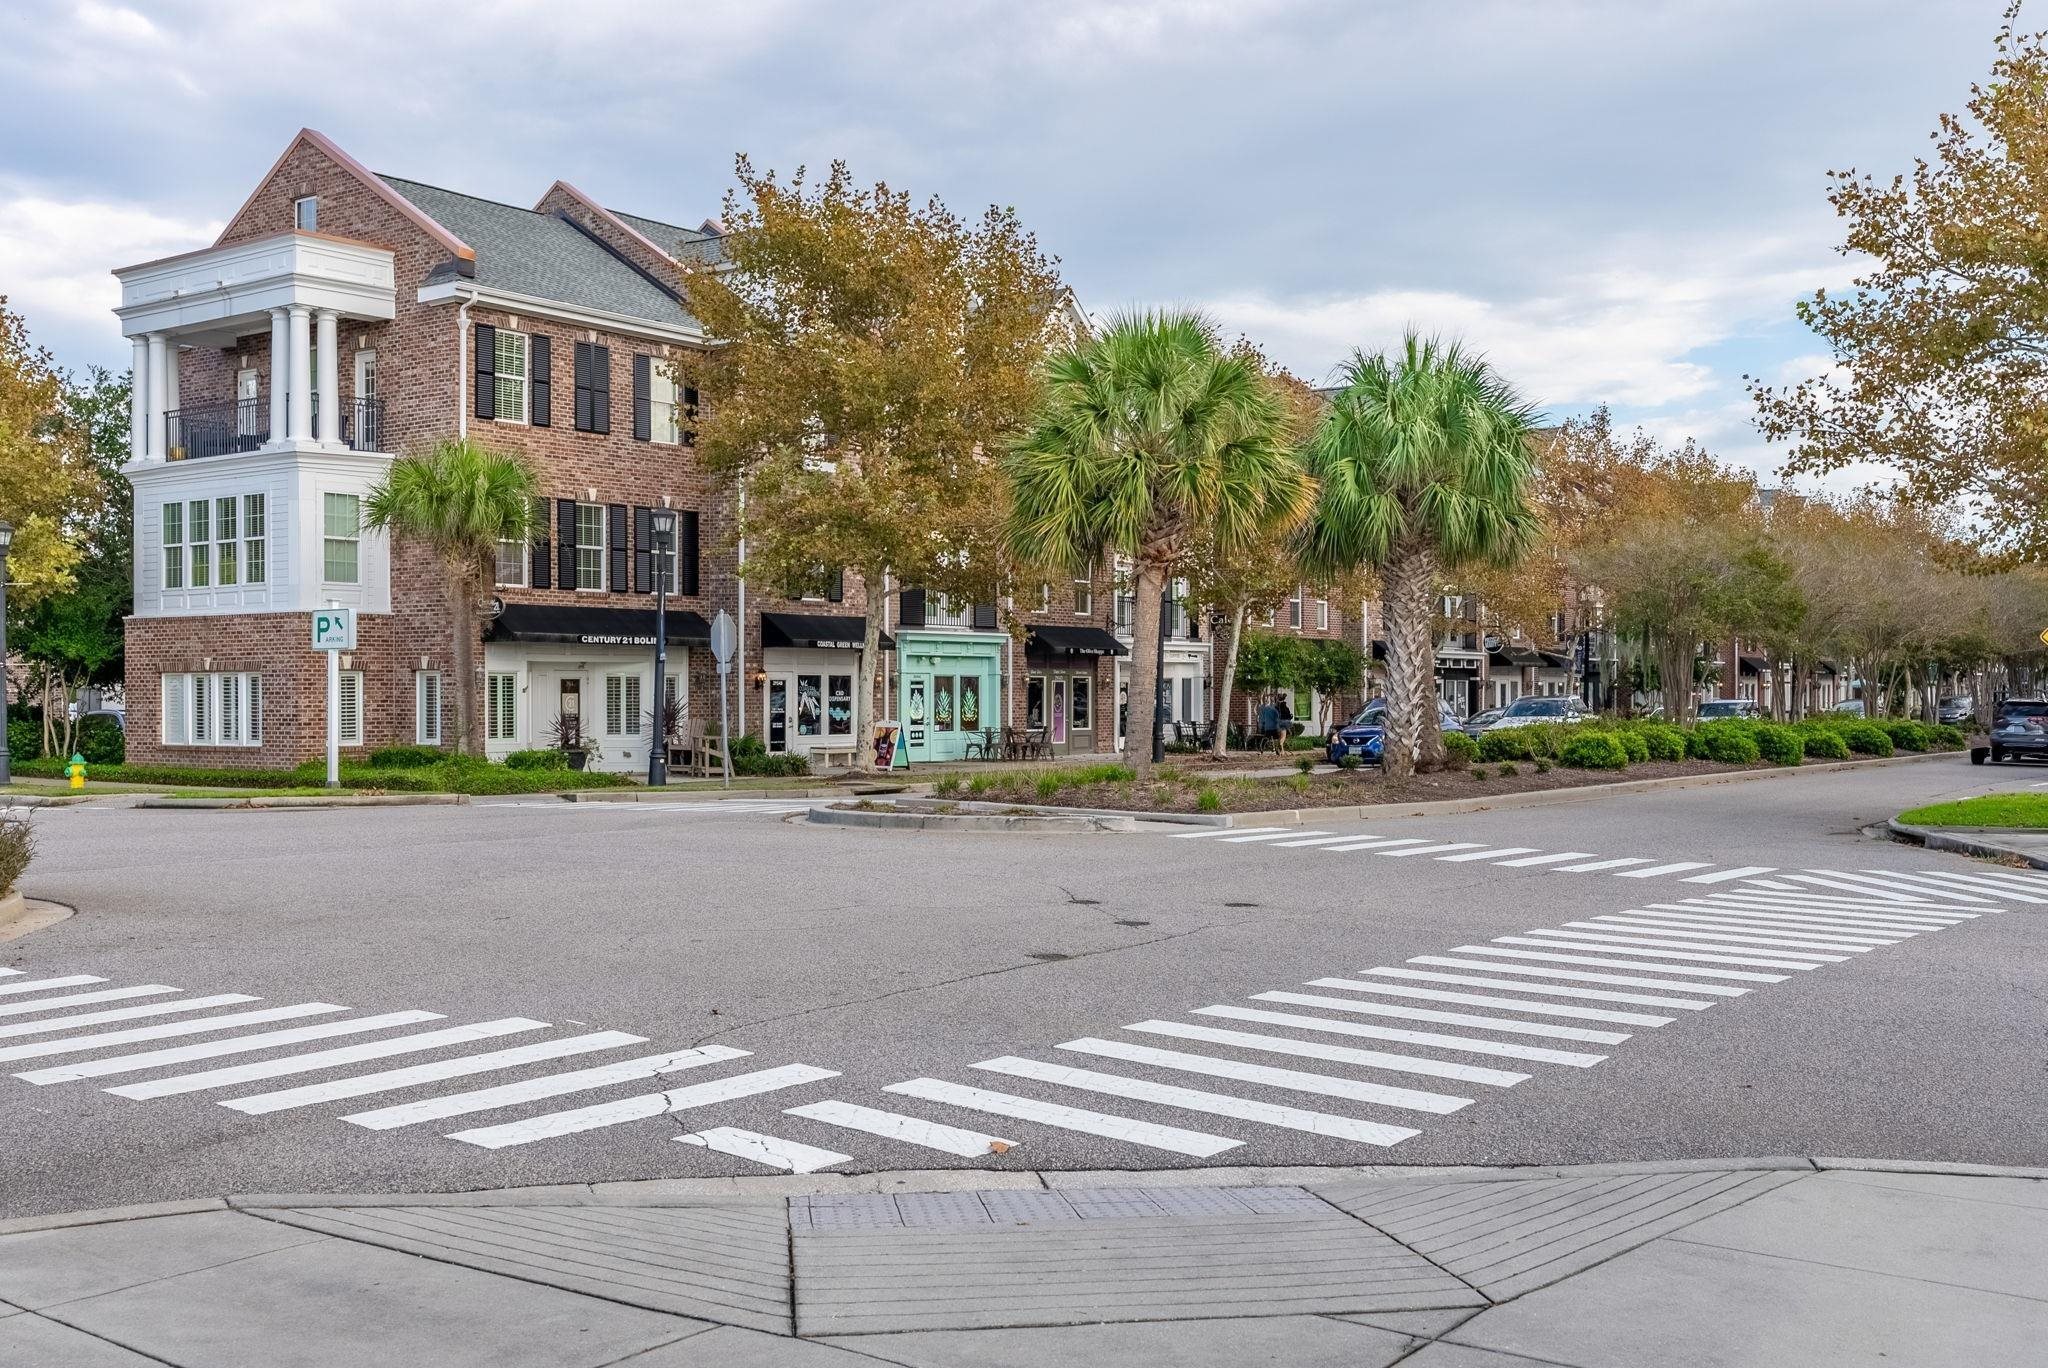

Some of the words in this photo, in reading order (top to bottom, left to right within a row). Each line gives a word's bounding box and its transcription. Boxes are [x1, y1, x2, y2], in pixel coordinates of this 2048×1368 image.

[581, 635, 621, 644] CENTURY
[622, 636, 633, 644] 21
[816, 640, 835, 648] COASTAL
[836, 641, 851, 649] GREEN
